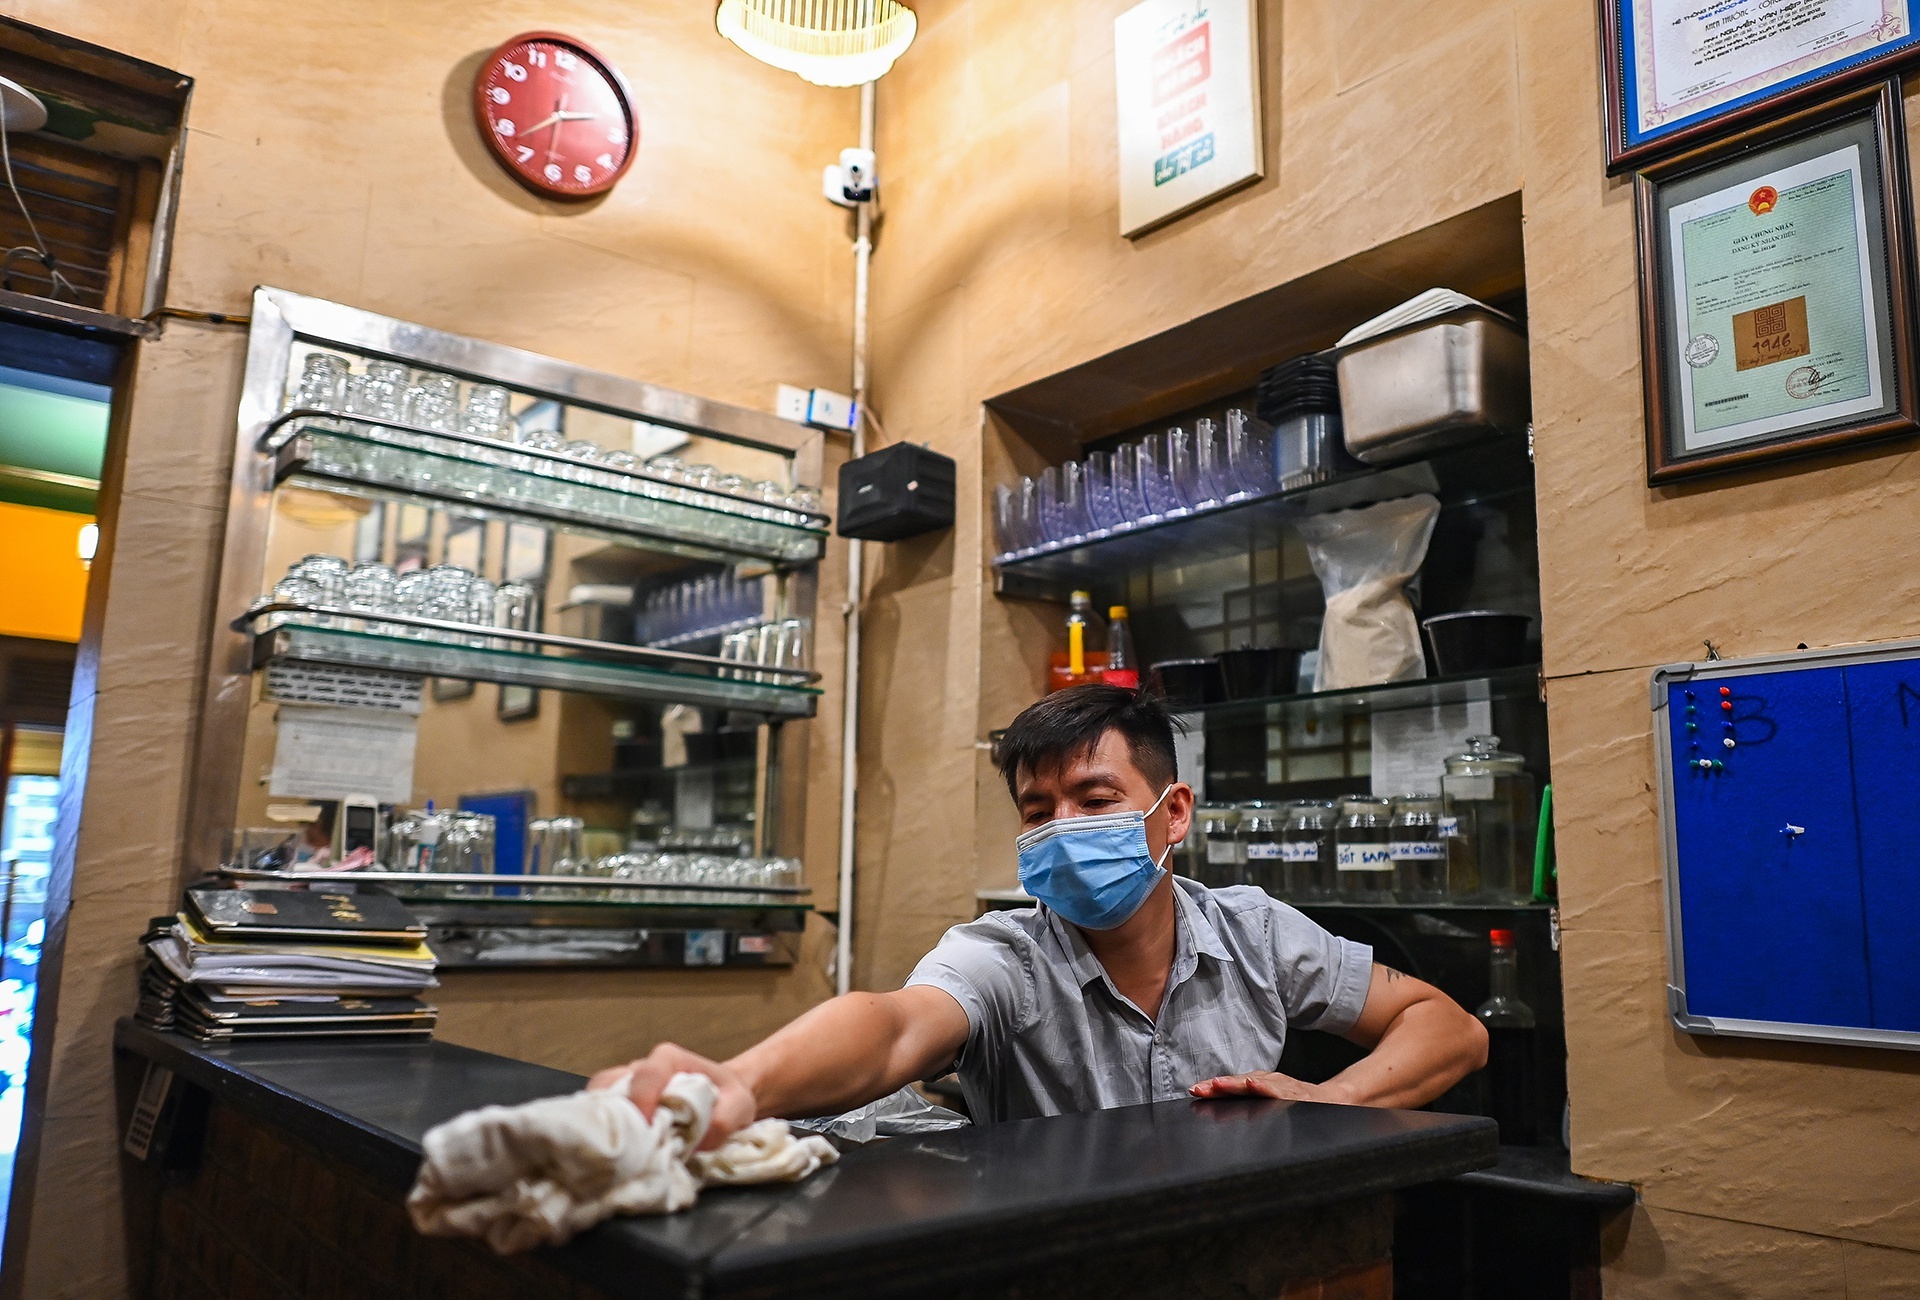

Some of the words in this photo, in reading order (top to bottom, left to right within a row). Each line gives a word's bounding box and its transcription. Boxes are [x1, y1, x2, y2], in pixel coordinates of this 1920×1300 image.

[1734, 35, 1767, 50] EMPLOYEE
[1812, 11, 1826, 20] 2012
[528, 48, 547, 68] 11
[503, 61, 528, 82] 10
[492, 86, 511, 105] 9
[516, 145, 535, 163] 7
[596, 152, 615, 170] 4
[544, 163, 563, 182] 6
[573, 164, 592, 183] 5
[1752, 332, 1791, 354] 1946
